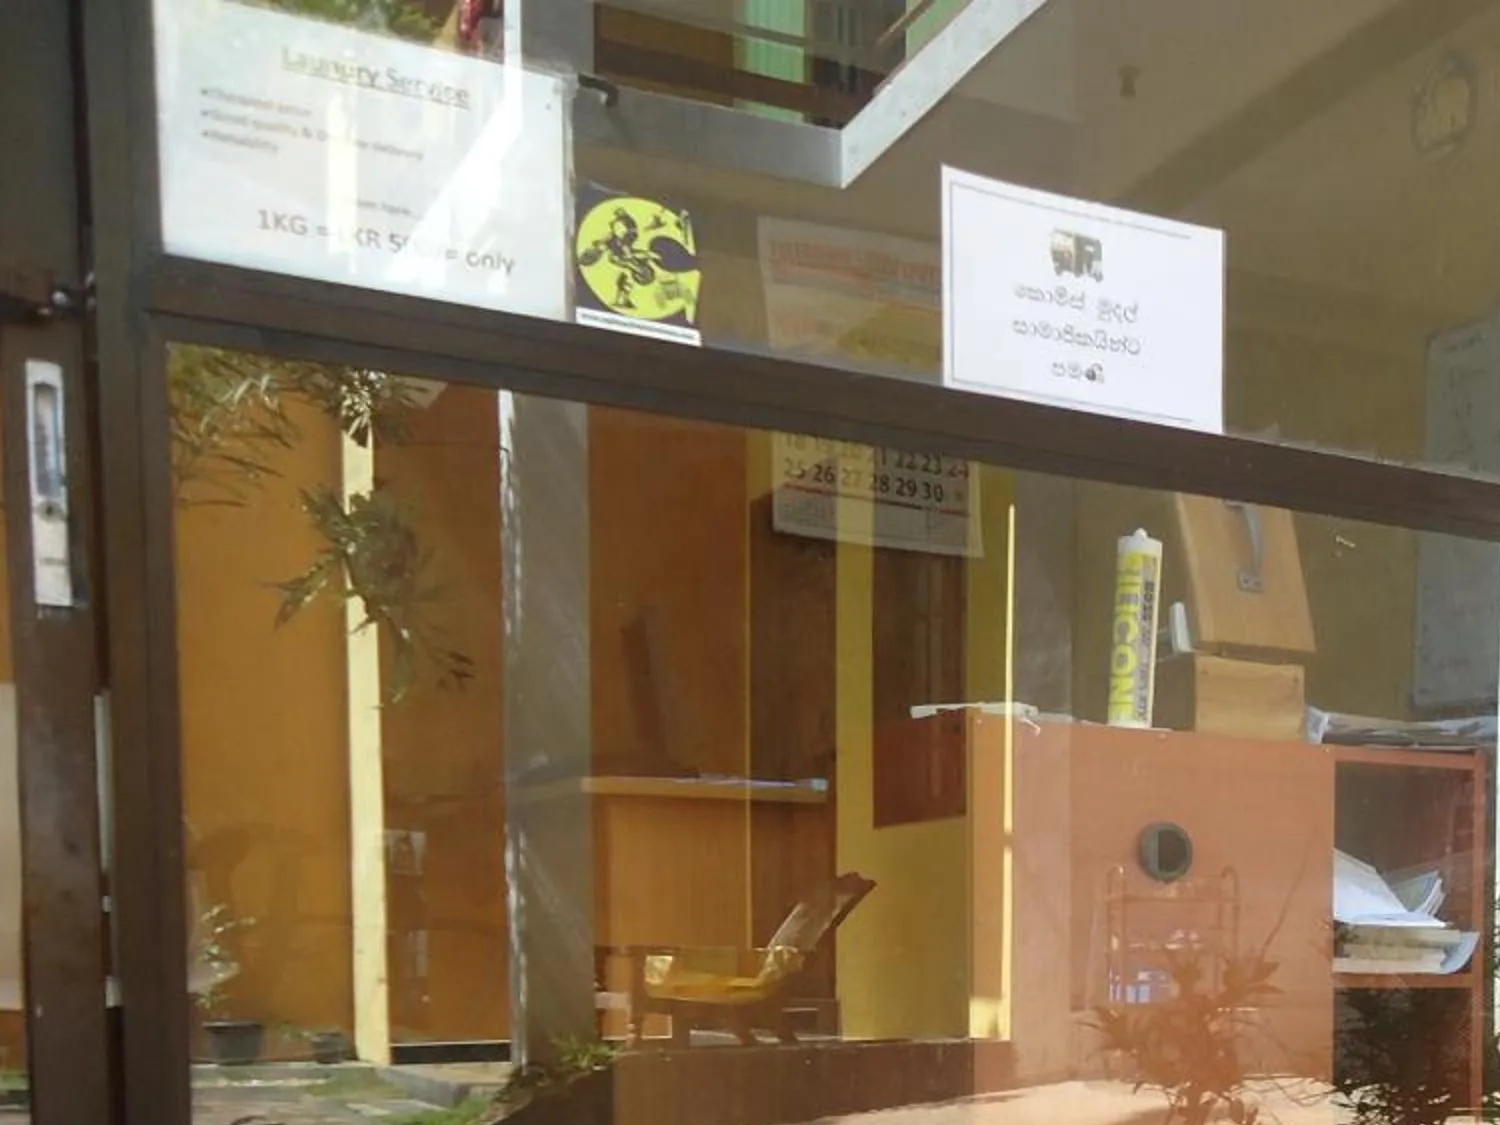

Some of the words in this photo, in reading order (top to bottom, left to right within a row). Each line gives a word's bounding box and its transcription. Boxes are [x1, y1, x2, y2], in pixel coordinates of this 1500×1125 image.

[385, 67, 471, 107] Service
[257, 208, 309, 238] 1KG
[465, 250, 516, 277] only
[784, 457, 806, 480] 25
[813, 463, 837, 484] 26
[868, 473, 891, 494] 28
[895, 477, 918, 498] 29
[921, 482, 944, 503] 30
[921, 453, 943, 475] 23
